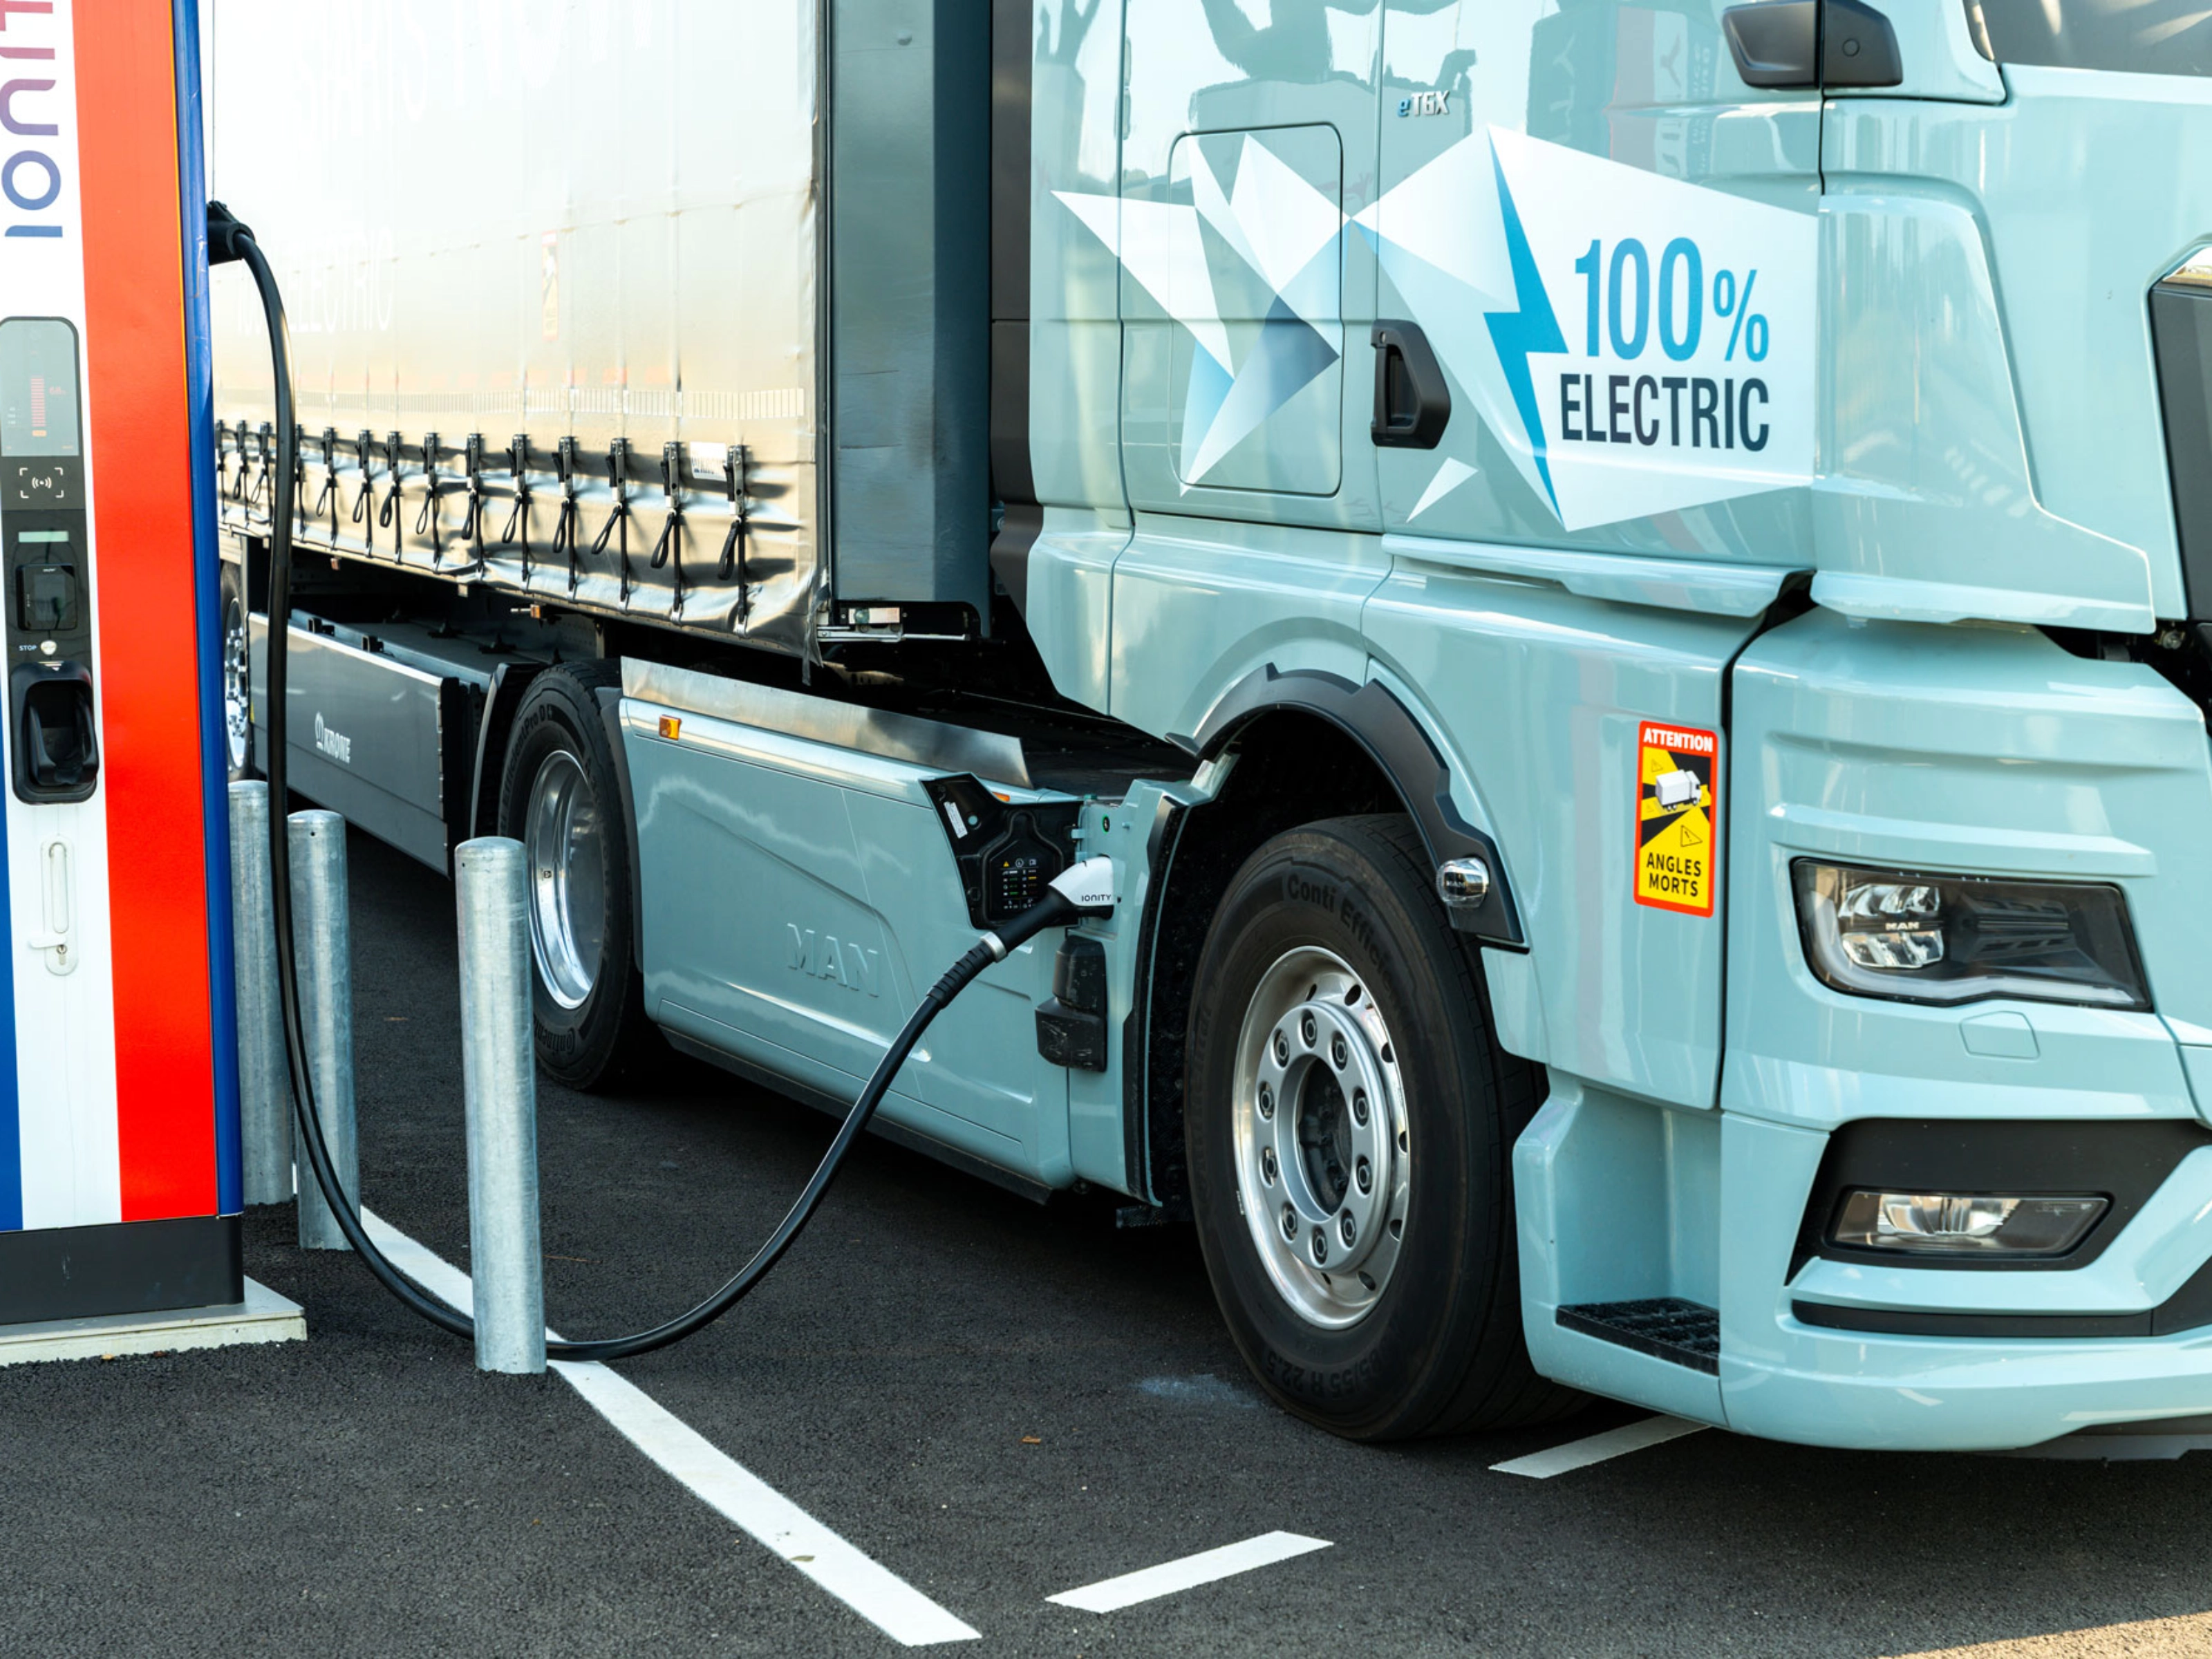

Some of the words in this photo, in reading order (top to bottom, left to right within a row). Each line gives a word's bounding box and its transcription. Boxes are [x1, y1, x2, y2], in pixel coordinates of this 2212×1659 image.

[1574, 236, 1770, 363] 100%
[1559, 373, 1770, 453] ELECTRIC
[323, 727, 351, 764] KRONE
[1643, 727, 1714, 753] ATTENTION
[1647, 852, 1702, 878] ANGLES
[1081, 894, 1112, 902] IONITY
[1287, 873, 1338, 913] Conti
[1649, 872, 1699, 897] MORTS
[1885, 921, 1920, 931] MAN
[787, 922, 880, 998] MAN
